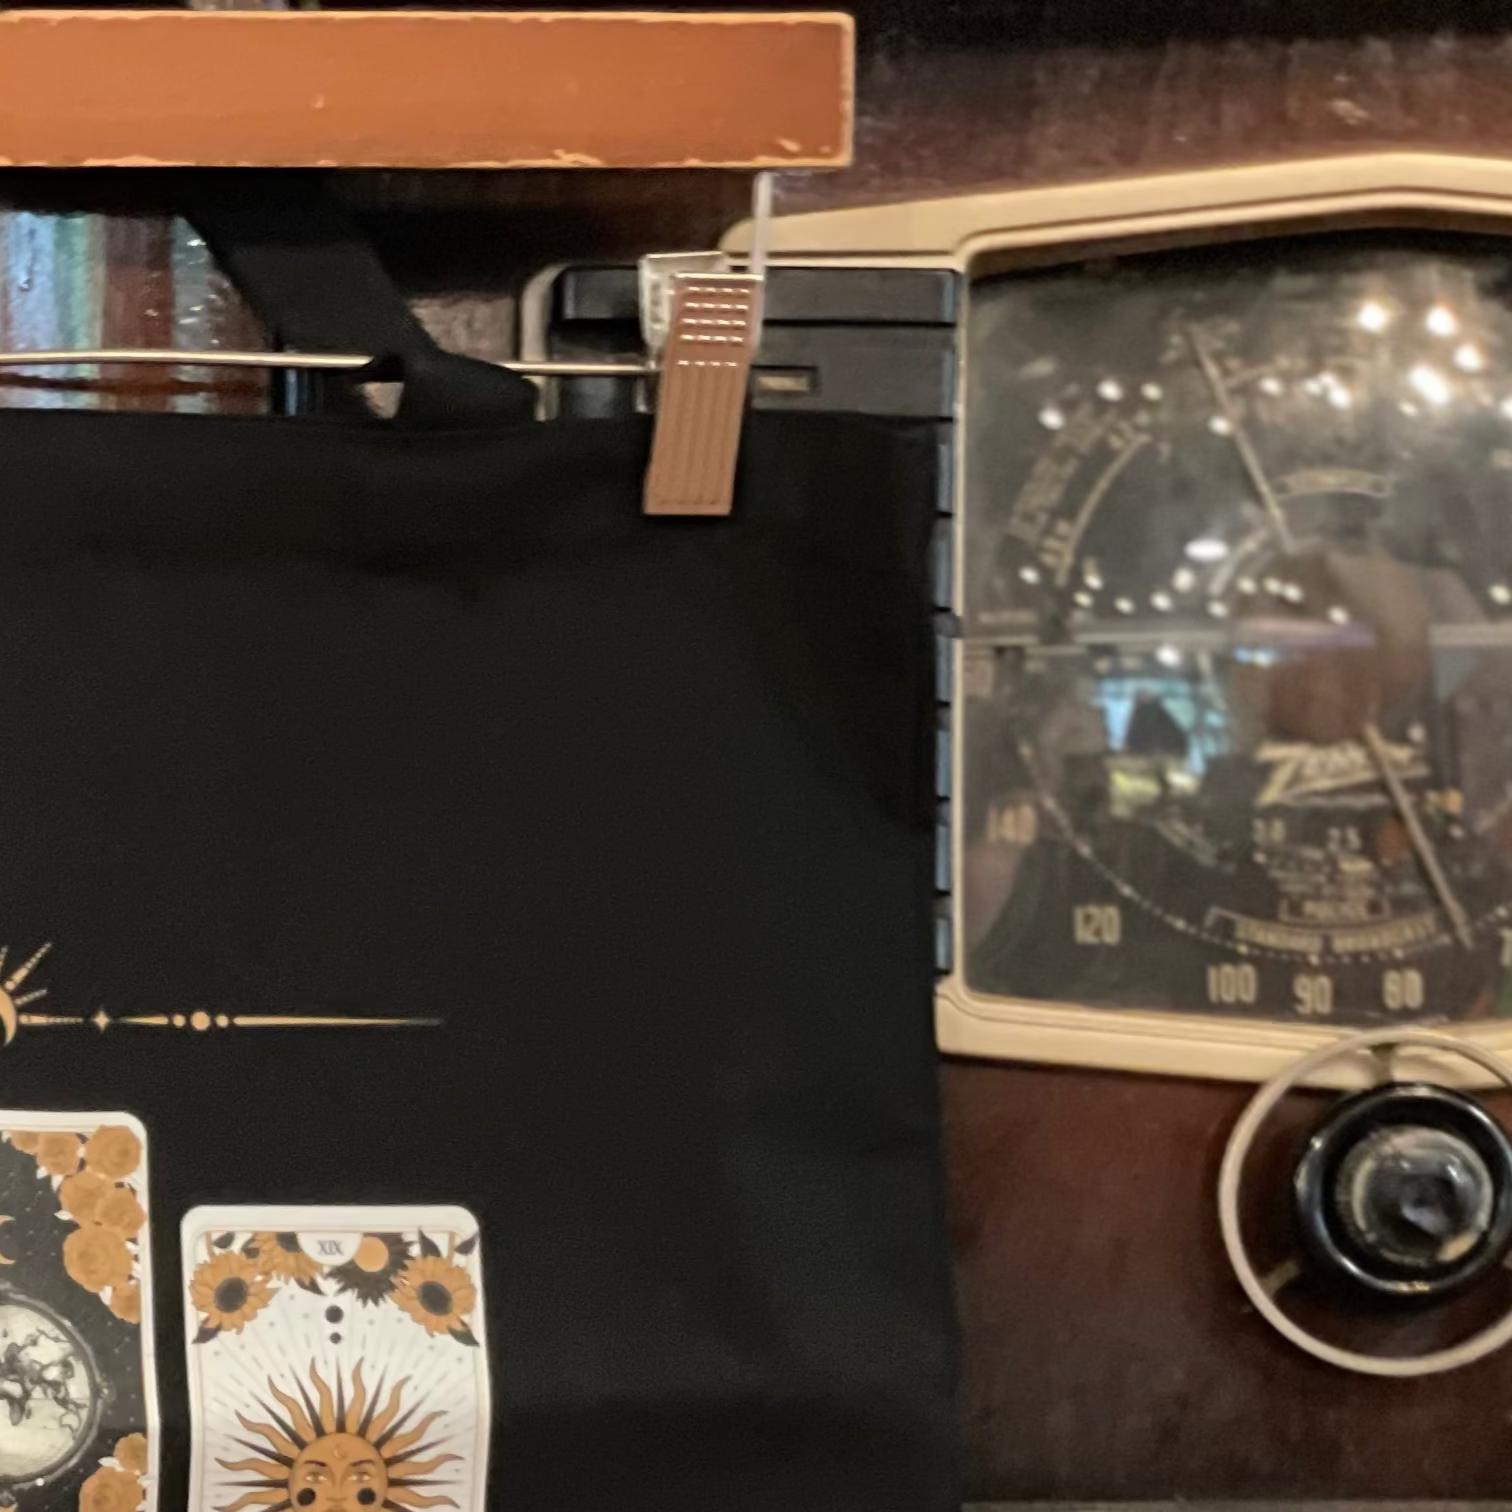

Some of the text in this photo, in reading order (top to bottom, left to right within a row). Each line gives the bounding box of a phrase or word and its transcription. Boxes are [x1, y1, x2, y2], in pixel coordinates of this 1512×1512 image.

[1074, 904, 1122, 945] 120
[1207, 963, 1257, 1004] 100
[1293, 973, 1334, 1015] 90
